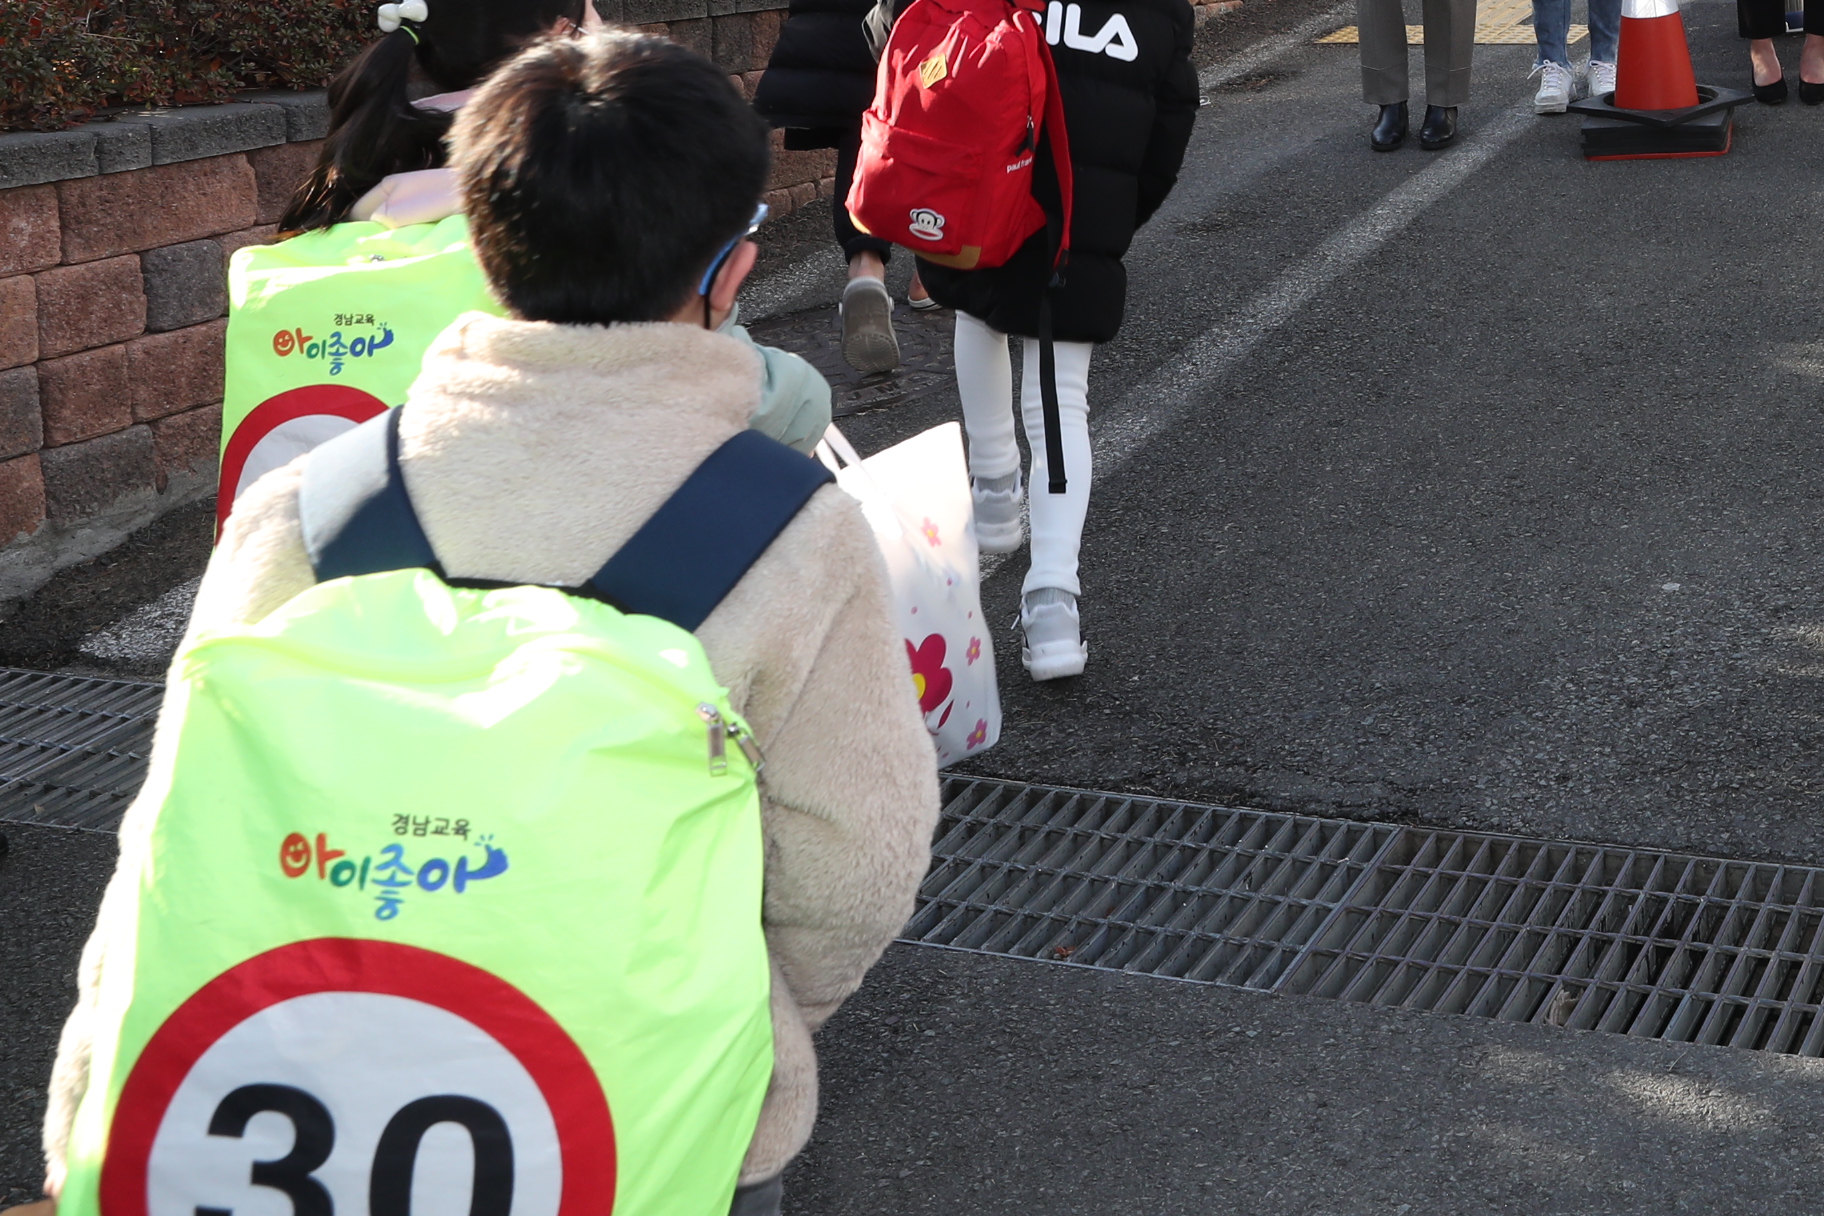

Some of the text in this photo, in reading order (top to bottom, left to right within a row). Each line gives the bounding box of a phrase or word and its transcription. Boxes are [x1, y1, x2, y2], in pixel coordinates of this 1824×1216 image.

[334, 313, 375, 326] 경남교육
[273, 327, 394, 376] 아이좋아
[392, 813, 471, 841] 경남교육
[280, 832, 509, 921] 아이좋아
[194, 1082, 515, 1216] 30
